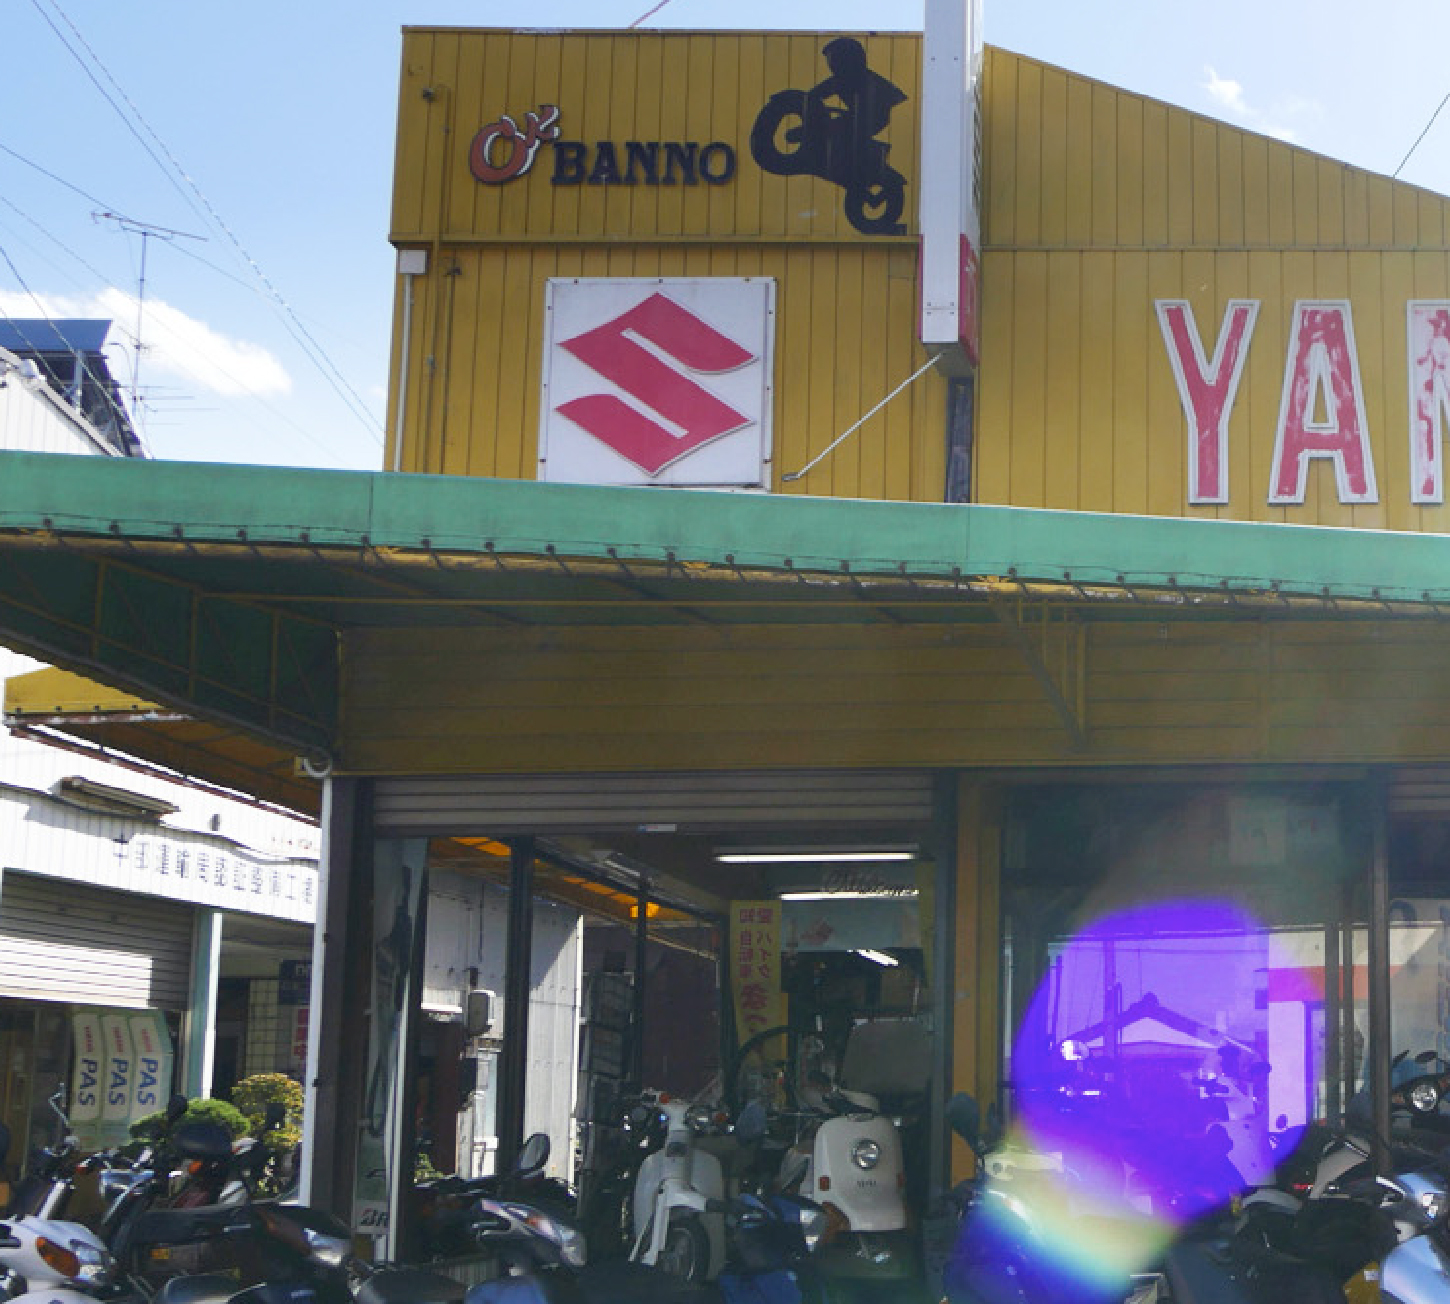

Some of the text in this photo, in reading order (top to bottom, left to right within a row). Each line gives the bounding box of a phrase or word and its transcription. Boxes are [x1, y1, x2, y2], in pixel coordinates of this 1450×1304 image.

[551, 141, 736, 185] BANNO
[78, 1057, 98, 1106] PAS
[108, 1057, 129, 1106] PAS
[137, 1057, 159, 1106] PAS
